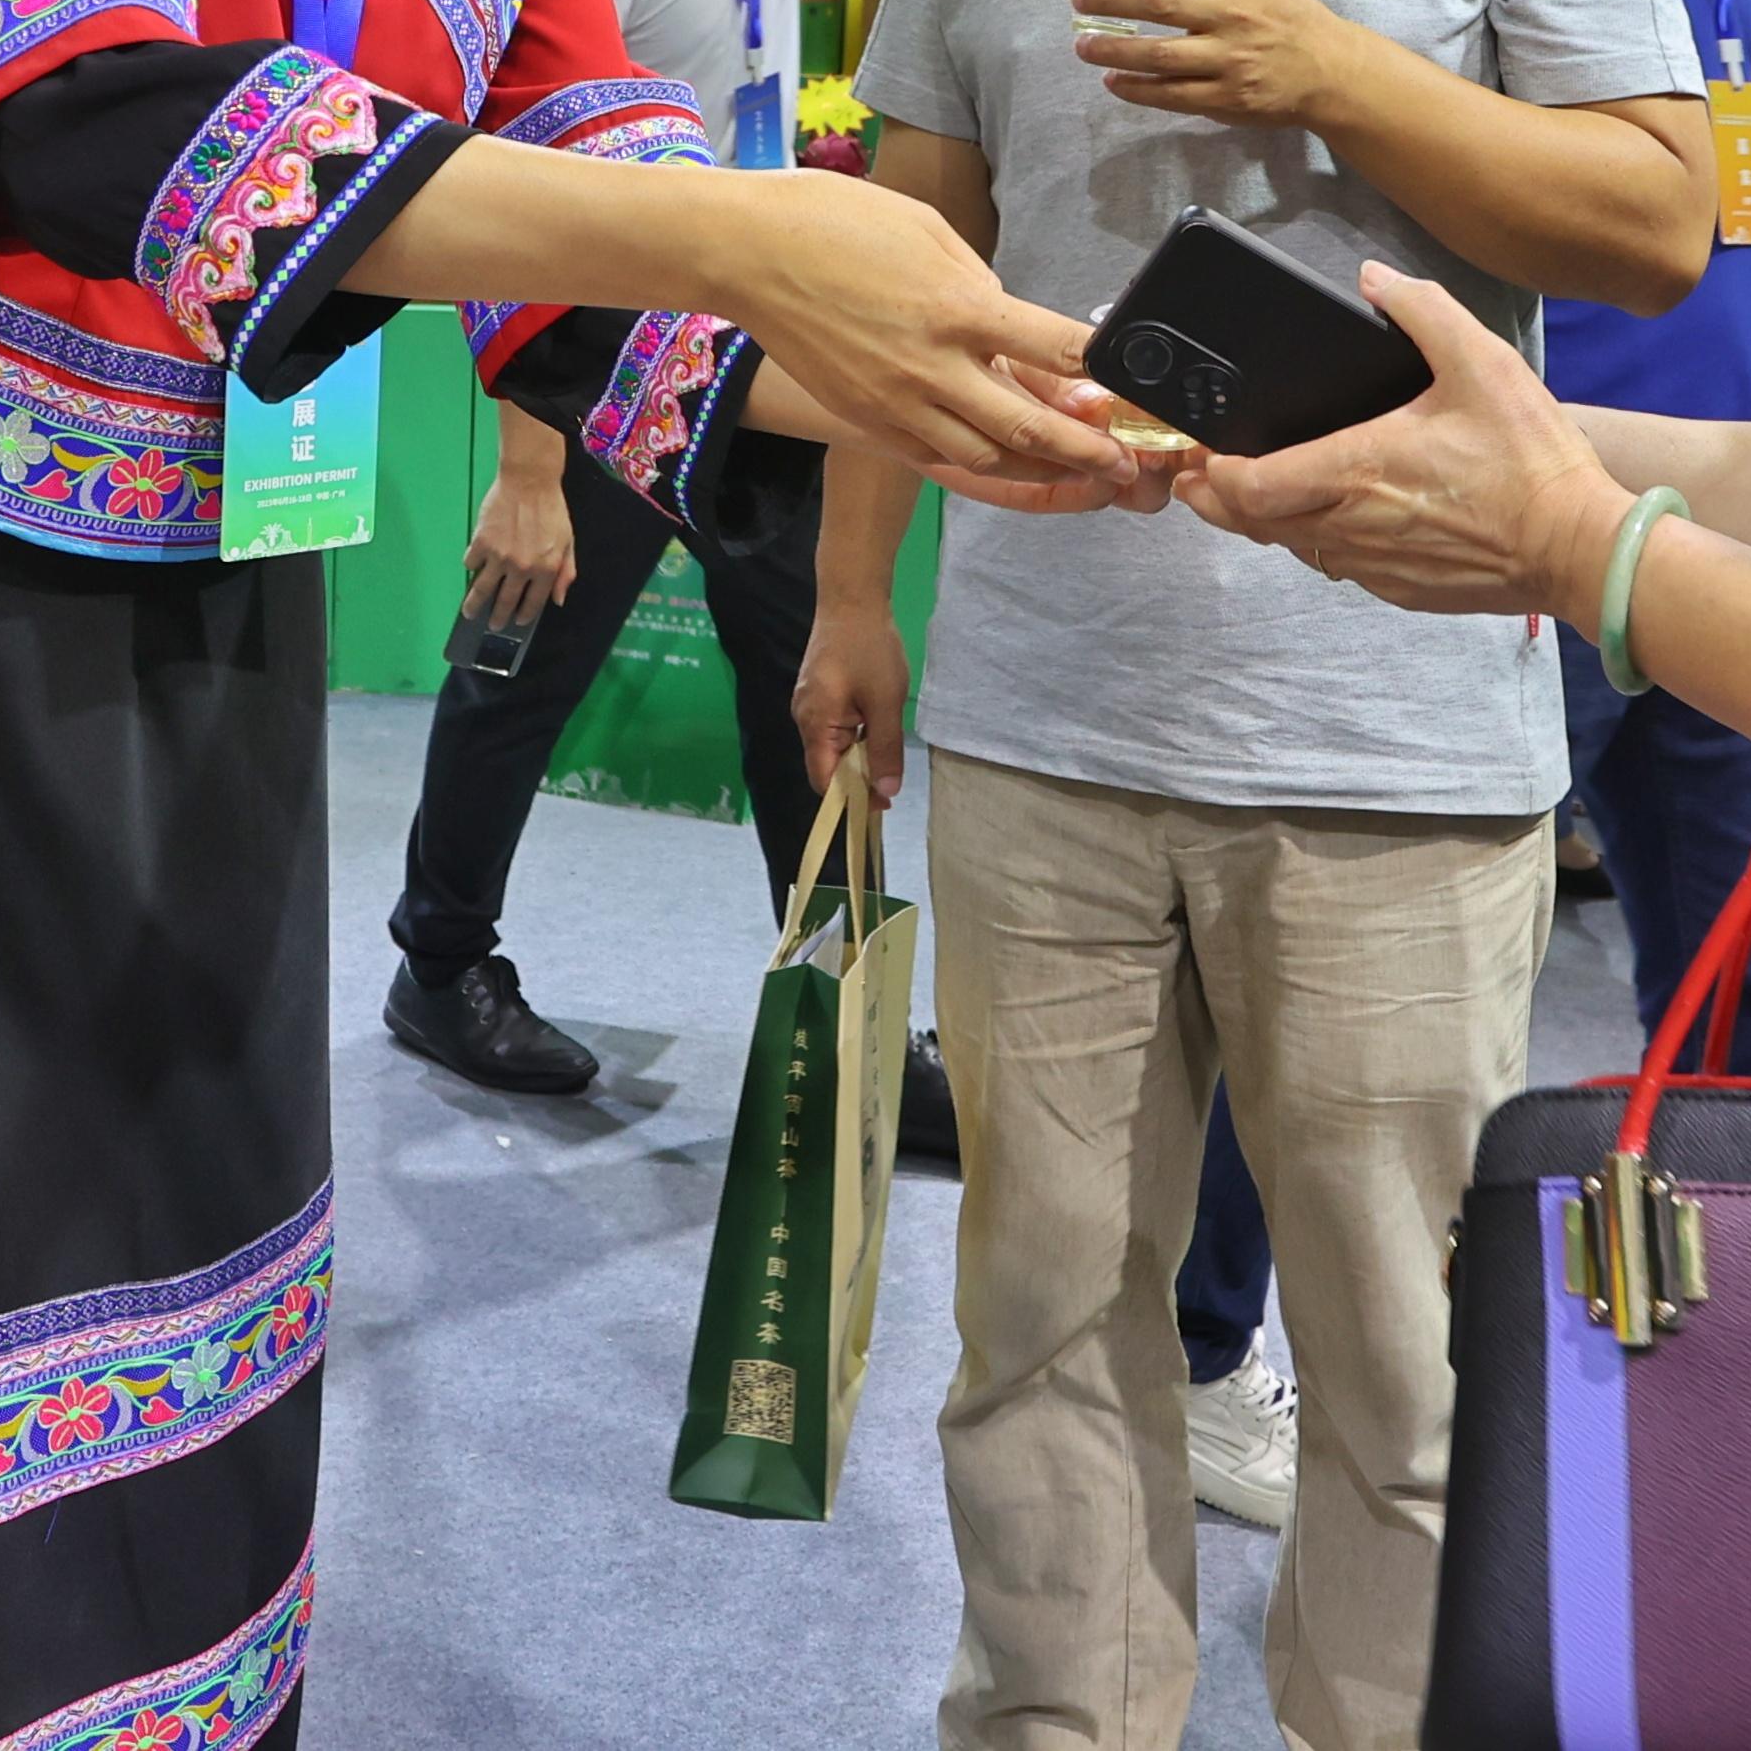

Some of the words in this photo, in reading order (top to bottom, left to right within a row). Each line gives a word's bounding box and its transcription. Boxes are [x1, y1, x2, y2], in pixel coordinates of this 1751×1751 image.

[291, 380, 316, 462] 展证
[244, 472, 312, 492] EXHIBITION
[314, 467, 358, 484] PERMIT
[756, 1222, 790, 1345] 中国名茶
